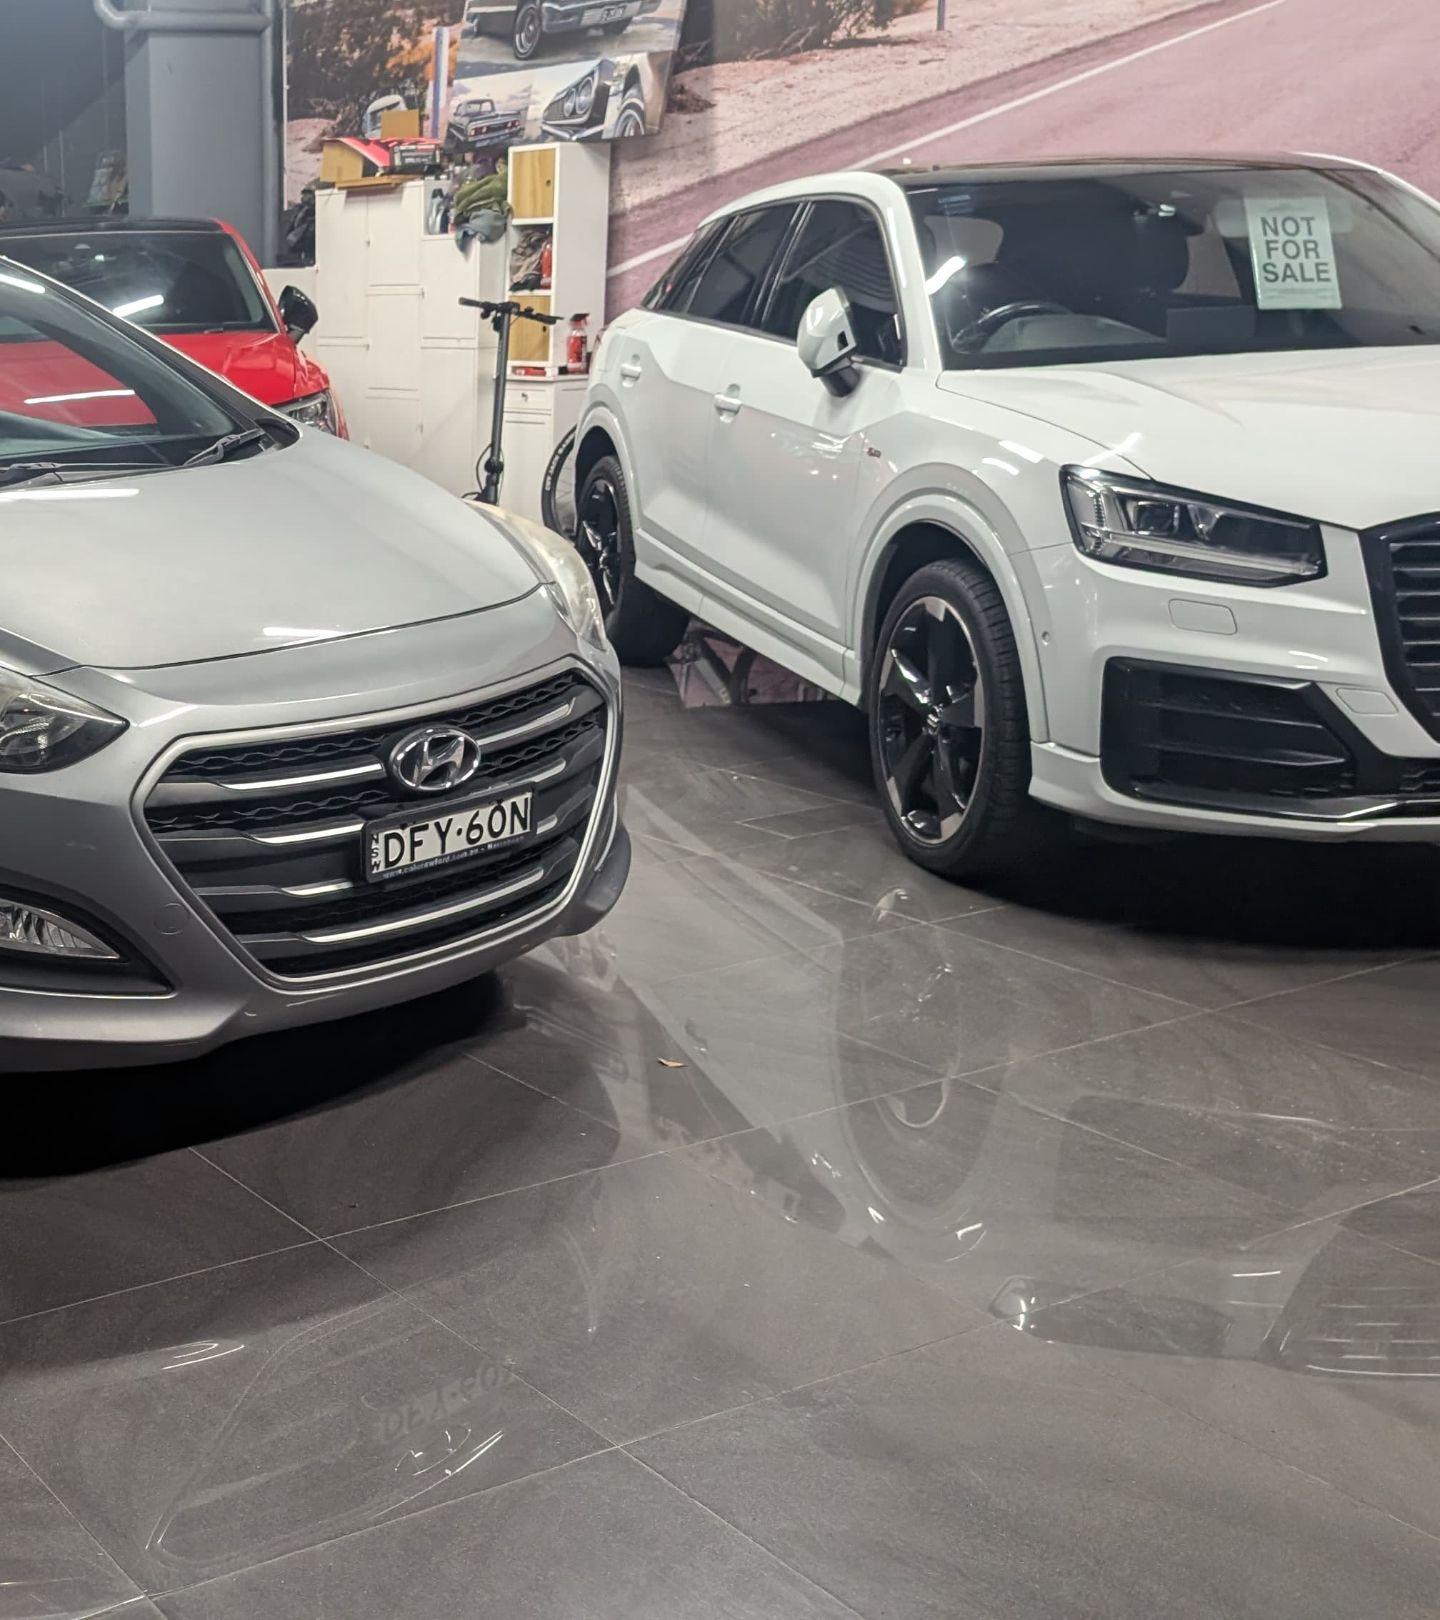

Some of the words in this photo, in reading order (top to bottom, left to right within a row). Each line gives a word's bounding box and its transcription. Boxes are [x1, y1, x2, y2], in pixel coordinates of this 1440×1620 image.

[1261, 216, 1316, 237] NOT
[1265, 239, 1321, 260] FOR
[1262, 262, 1331, 283] SALE
